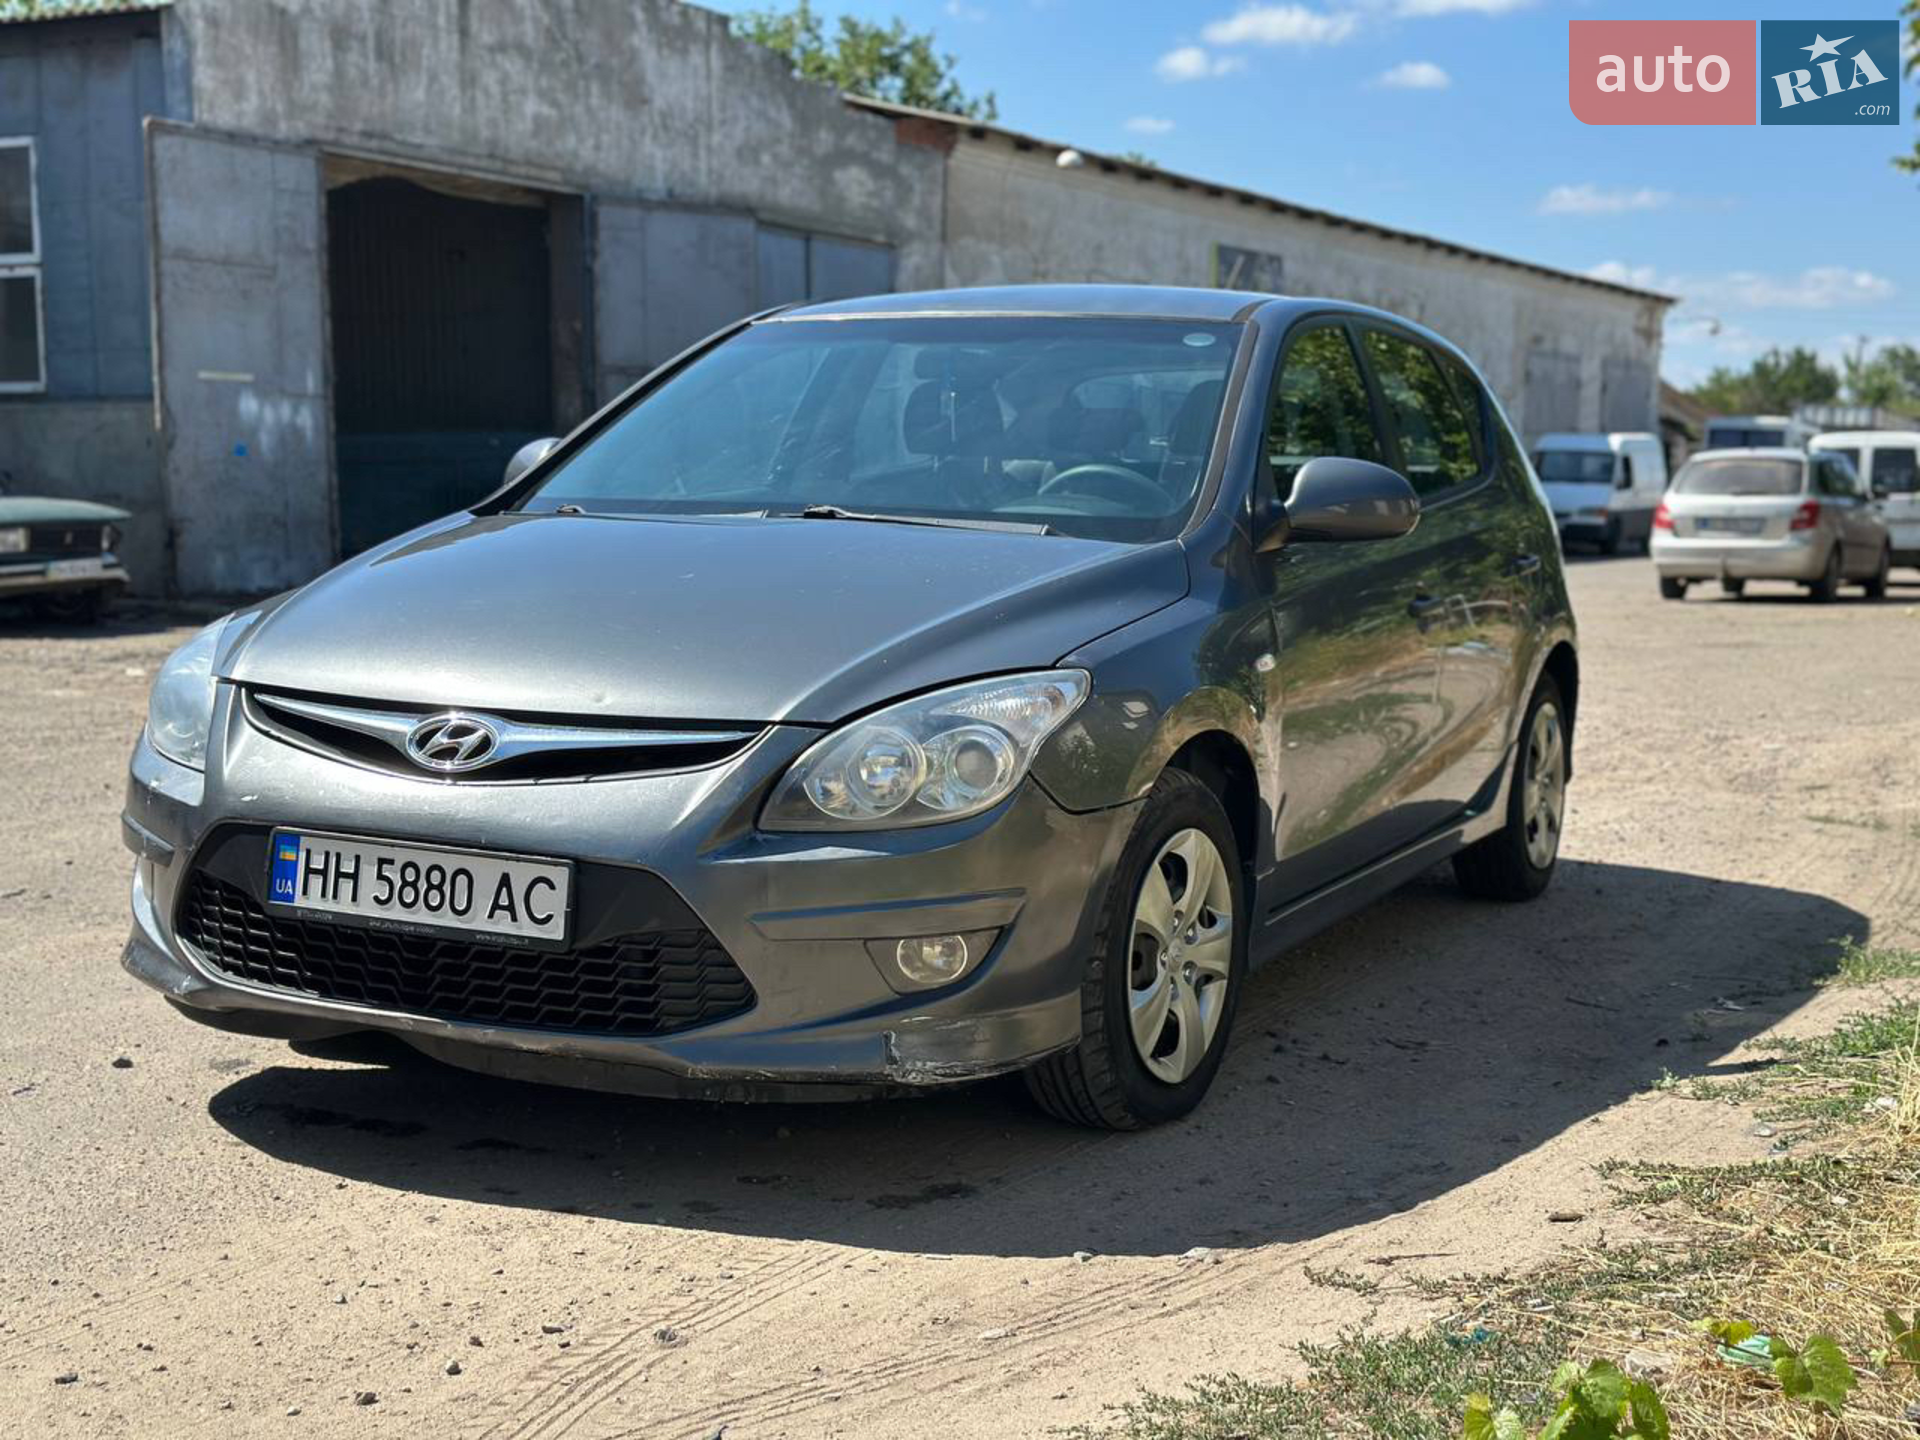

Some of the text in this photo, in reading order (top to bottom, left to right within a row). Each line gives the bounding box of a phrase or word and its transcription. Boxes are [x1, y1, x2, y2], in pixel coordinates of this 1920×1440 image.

[275, 878, 293, 895] UA
[302, 848, 557, 925] HH 5880 AC
